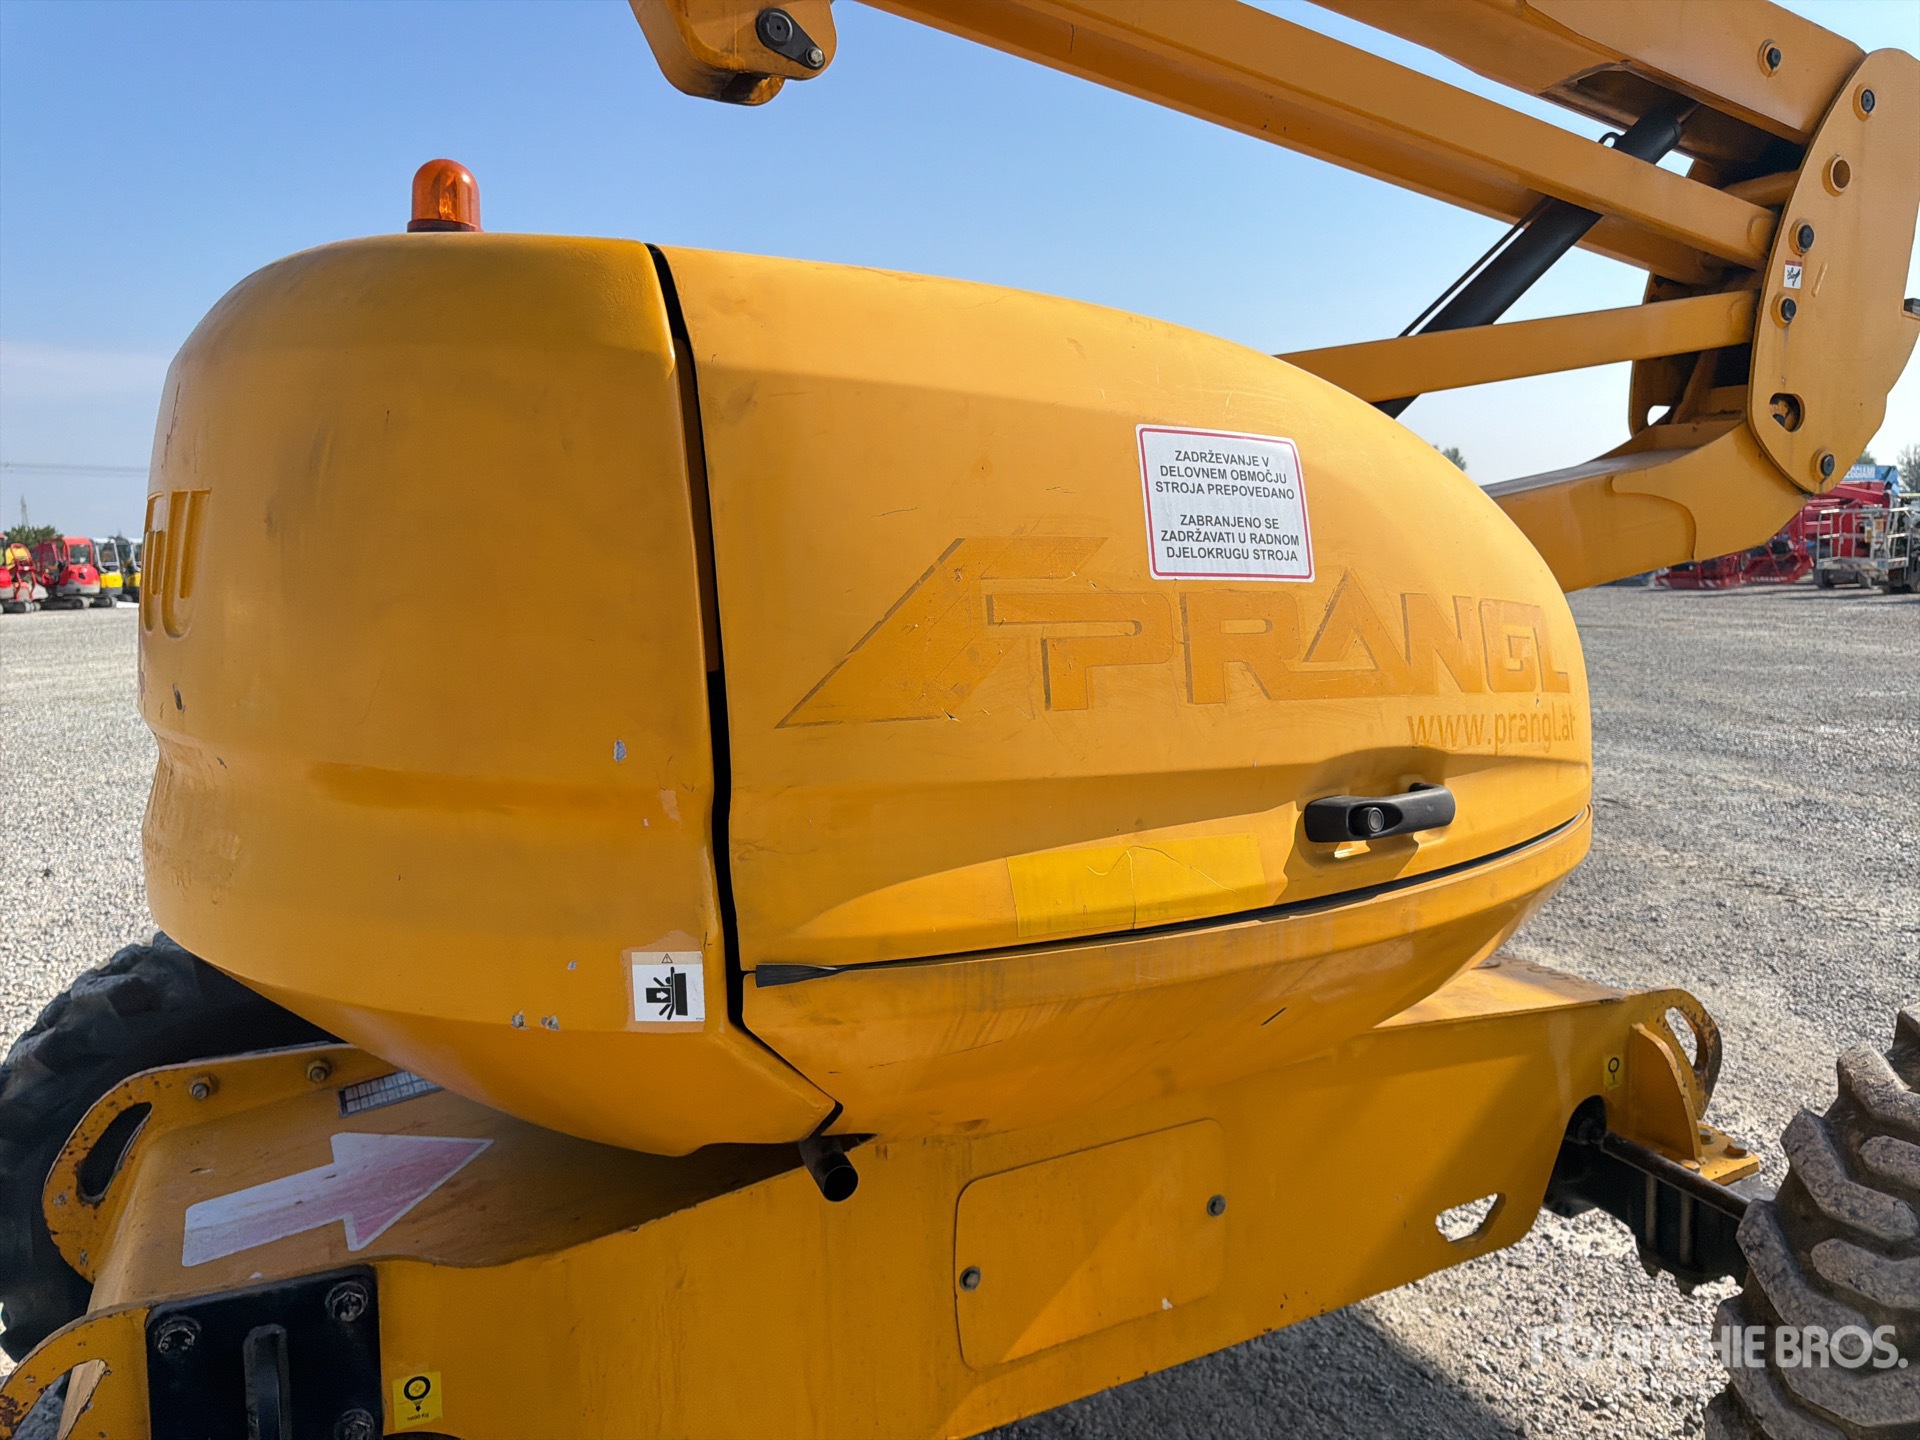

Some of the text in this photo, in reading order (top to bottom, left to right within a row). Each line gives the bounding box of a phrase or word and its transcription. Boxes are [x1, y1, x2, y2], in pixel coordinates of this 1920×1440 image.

[1175, 450, 1269, 467] ZADRŽEVANJE V
[1160, 465, 1287, 484] DELOVNEM OBMOČJU
[1155, 481, 1295, 500] STROJA PREPOVEDANO
[1180, 514, 1280, 530] ZABRANJENO SE
[1161, 528, 1299, 546] ZADRŽAVATI U RADNOM
[1166, 546, 1298, 562] DJELOKRUGU STROJA
[985, 568, 1571, 712] PRANGL
[1407, 705, 1576, 756] www.prangl.at
